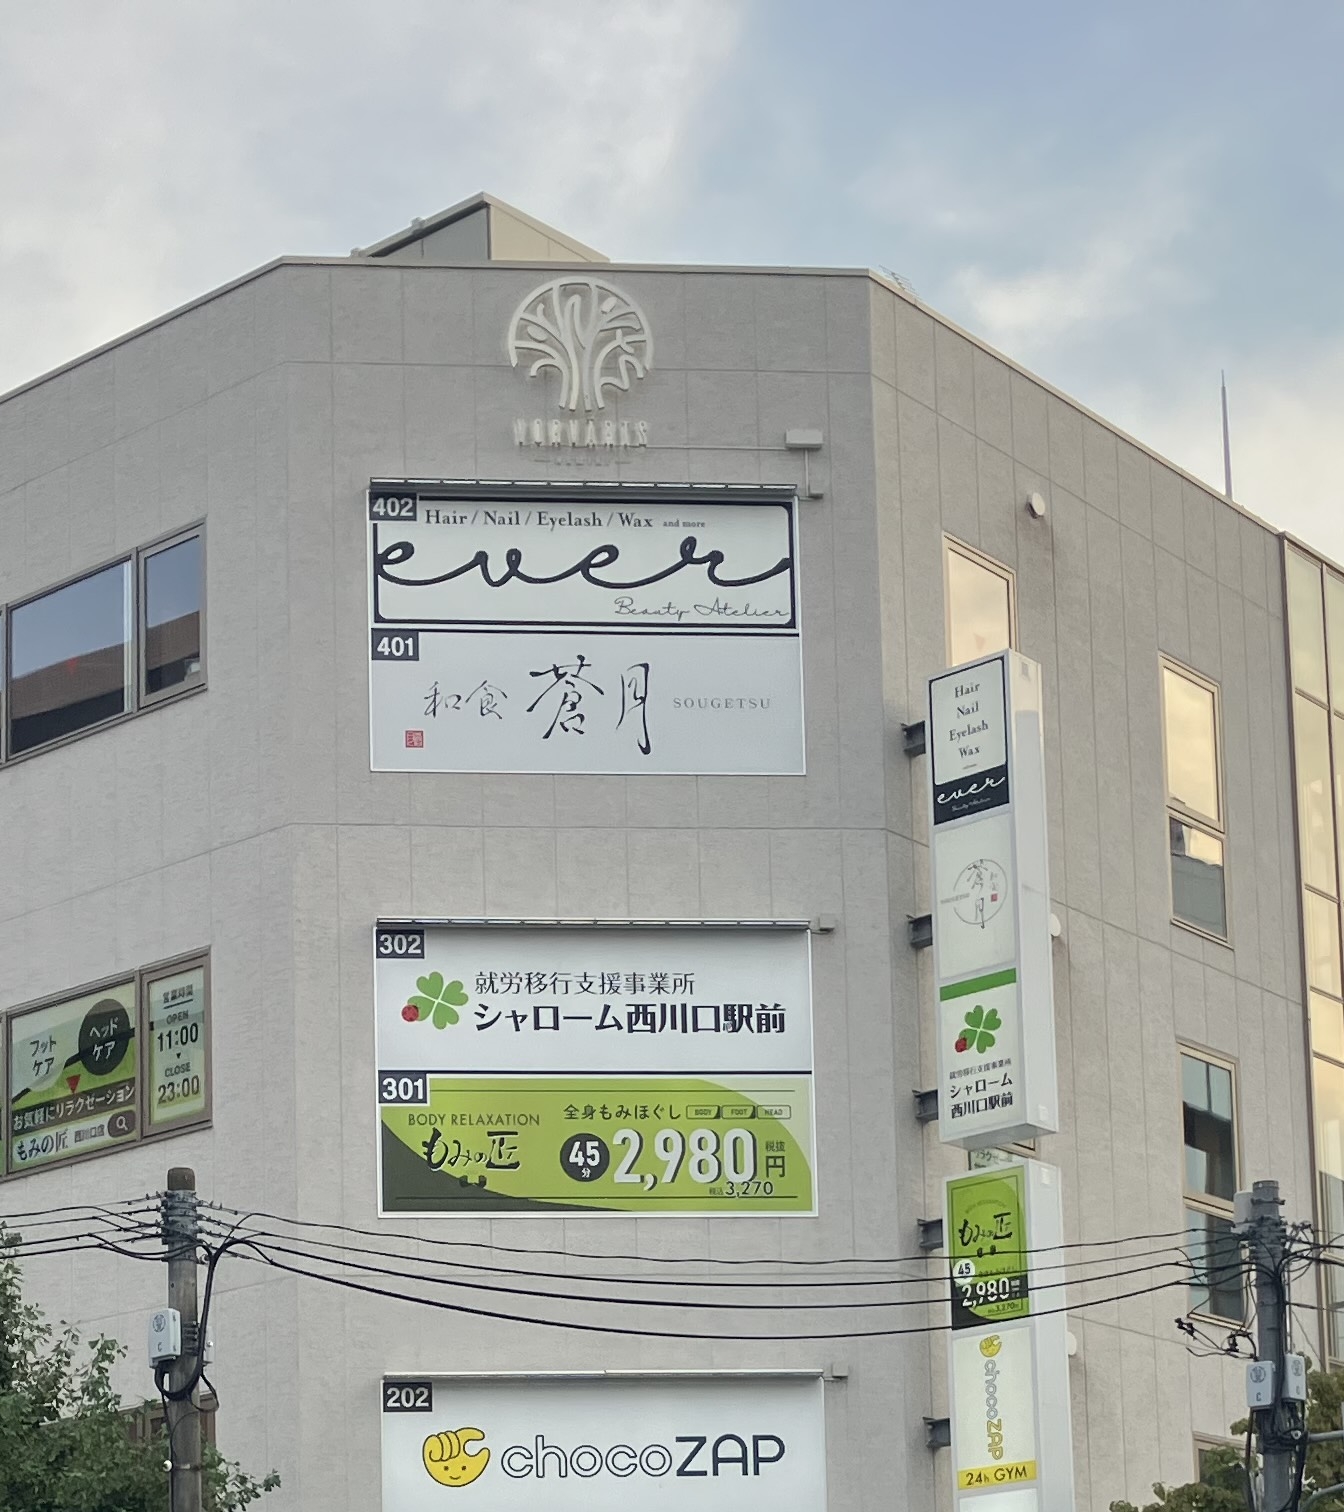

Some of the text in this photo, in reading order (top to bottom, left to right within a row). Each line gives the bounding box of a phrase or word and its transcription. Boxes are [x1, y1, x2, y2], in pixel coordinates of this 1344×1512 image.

[372, 497, 414, 517] 402
[425, 510, 469, 526] Hair
[483, 511, 520, 526] Nail
[536, 511, 603, 531] Eyelash
[619, 513, 654, 528] Wax
[663, 519, 680, 528] and
[682, 521, 706, 529] more
[377, 535, 790, 588] ever
[614, 597, 789, 620] Beauty Atelier
[376, 636, 414, 657] 401
[954, 681, 981, 699] Hair
[424, 654, 652, 755] 和食 蒼月
[673, 697, 770, 709] SOUGETSU
[956, 702, 979, 718] Nail
[949, 720, 989, 744] Eyelash
[959, 745, 980, 759] Wax
[937, 776, 1006, 804] ever
[379, 935, 422, 954] 302
[474, 971, 696, 996] 就労移行支援事業所
[89, 1016, 119, 1039] ヘッド
[166, 1010, 189, 1025] OPEN
[474, 1002, 786, 1034] シャローム西川口駅前
[30, 1035, 56, 1058] フット
[157, 1022, 199, 1052] 11:00
[92, 1041, 116, 1061] ケア
[32, 1057, 55, 1077] ケア
[164, 1062, 191, 1078] CLOSE
[158, 1075, 200, 1105] 23:00
[382, 1080, 424, 1099] 301
[949, 1072, 1013, 1099] シャローム
[13, 1085, 135, 1131] お気軽にリラクゼーション
[563, 1104, 681, 1120] 全身もみほぐし
[951, 1092, 1014, 1119] 西川口駅前
[408, 1113, 540, 1126] BODY RELAXATION
[17, 1128, 69, 1161] もみの匠
[422, 1127, 520, 1170] もみの匠
[569, 1141, 600, 1167] 45
[765, 1141, 785, 1152] 税抜
[612, 1128, 758, 1191] 2,980
[765, 1155, 786, 1178] 円
[581, 1168, 591, 1178] 分
[725, 1181, 774, 1198] 3,270
[958, 1263, 971, 1275] 45
[961, 1277, 1010, 1307] 2,980
[386, 1387, 430, 1408] 202
[984, 1359, 1004, 1460] chocoZAP
[501, 1434, 786, 1478] chocoZAP
[965, 1465, 1028, 1486] 24h GYM
